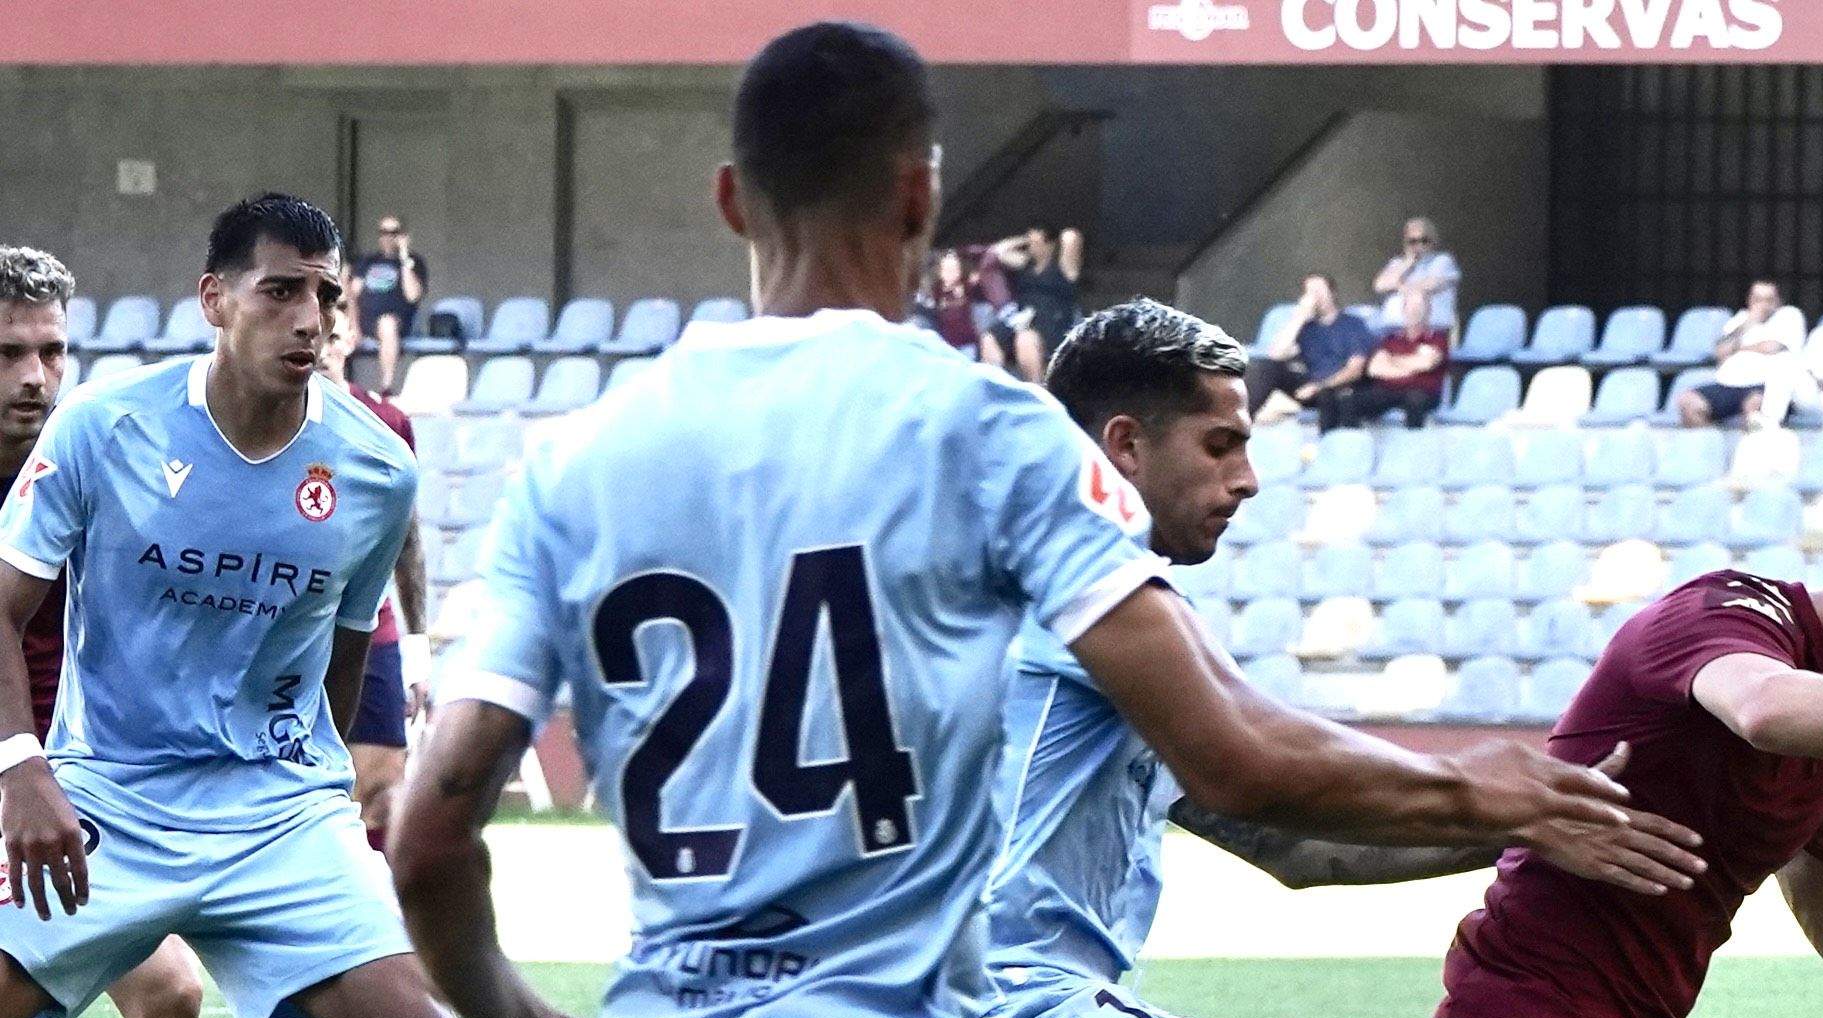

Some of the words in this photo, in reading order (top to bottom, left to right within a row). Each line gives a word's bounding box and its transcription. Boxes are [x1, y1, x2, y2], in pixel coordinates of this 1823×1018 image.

[1280, 0, 1784, 50] CONSERVAS
[137, 542, 332, 598] ASPIRE
[590, 541, 923, 883] 24
